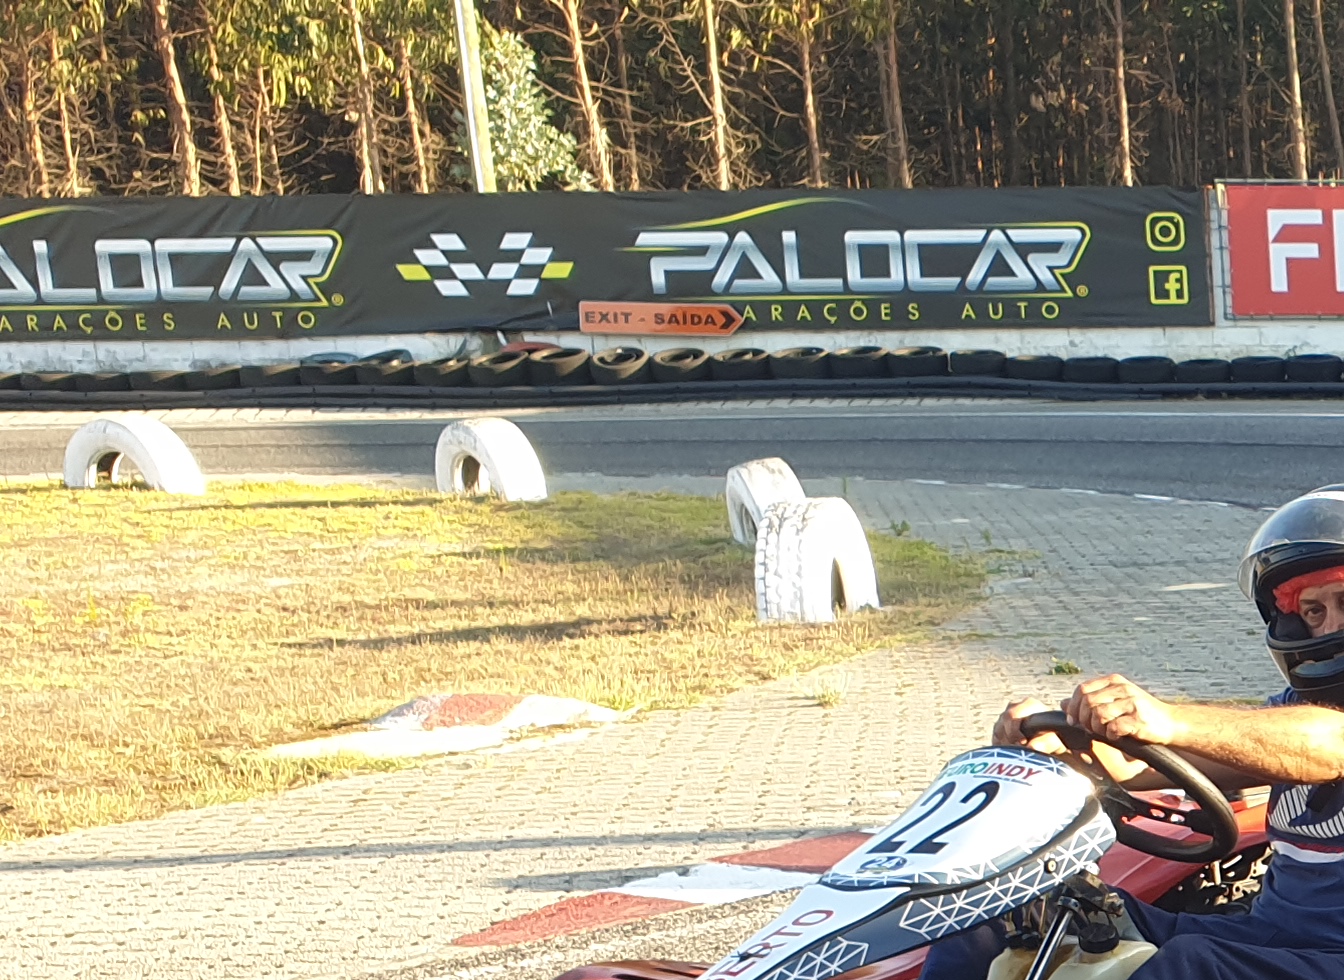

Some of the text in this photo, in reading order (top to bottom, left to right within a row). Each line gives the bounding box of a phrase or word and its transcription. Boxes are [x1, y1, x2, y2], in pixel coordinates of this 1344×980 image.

[635, 229, 1083, 295] PALOCAR
[217, 310, 316, 331] AUTO
[584, 310, 633, 324] EXIT
[653, 308, 718, 327] SAÍDA
[961, 301, 1060, 321] AUTO
[939, 762, 1042, 780] EUROINDY
[865, 780, 1000, 854] 22
